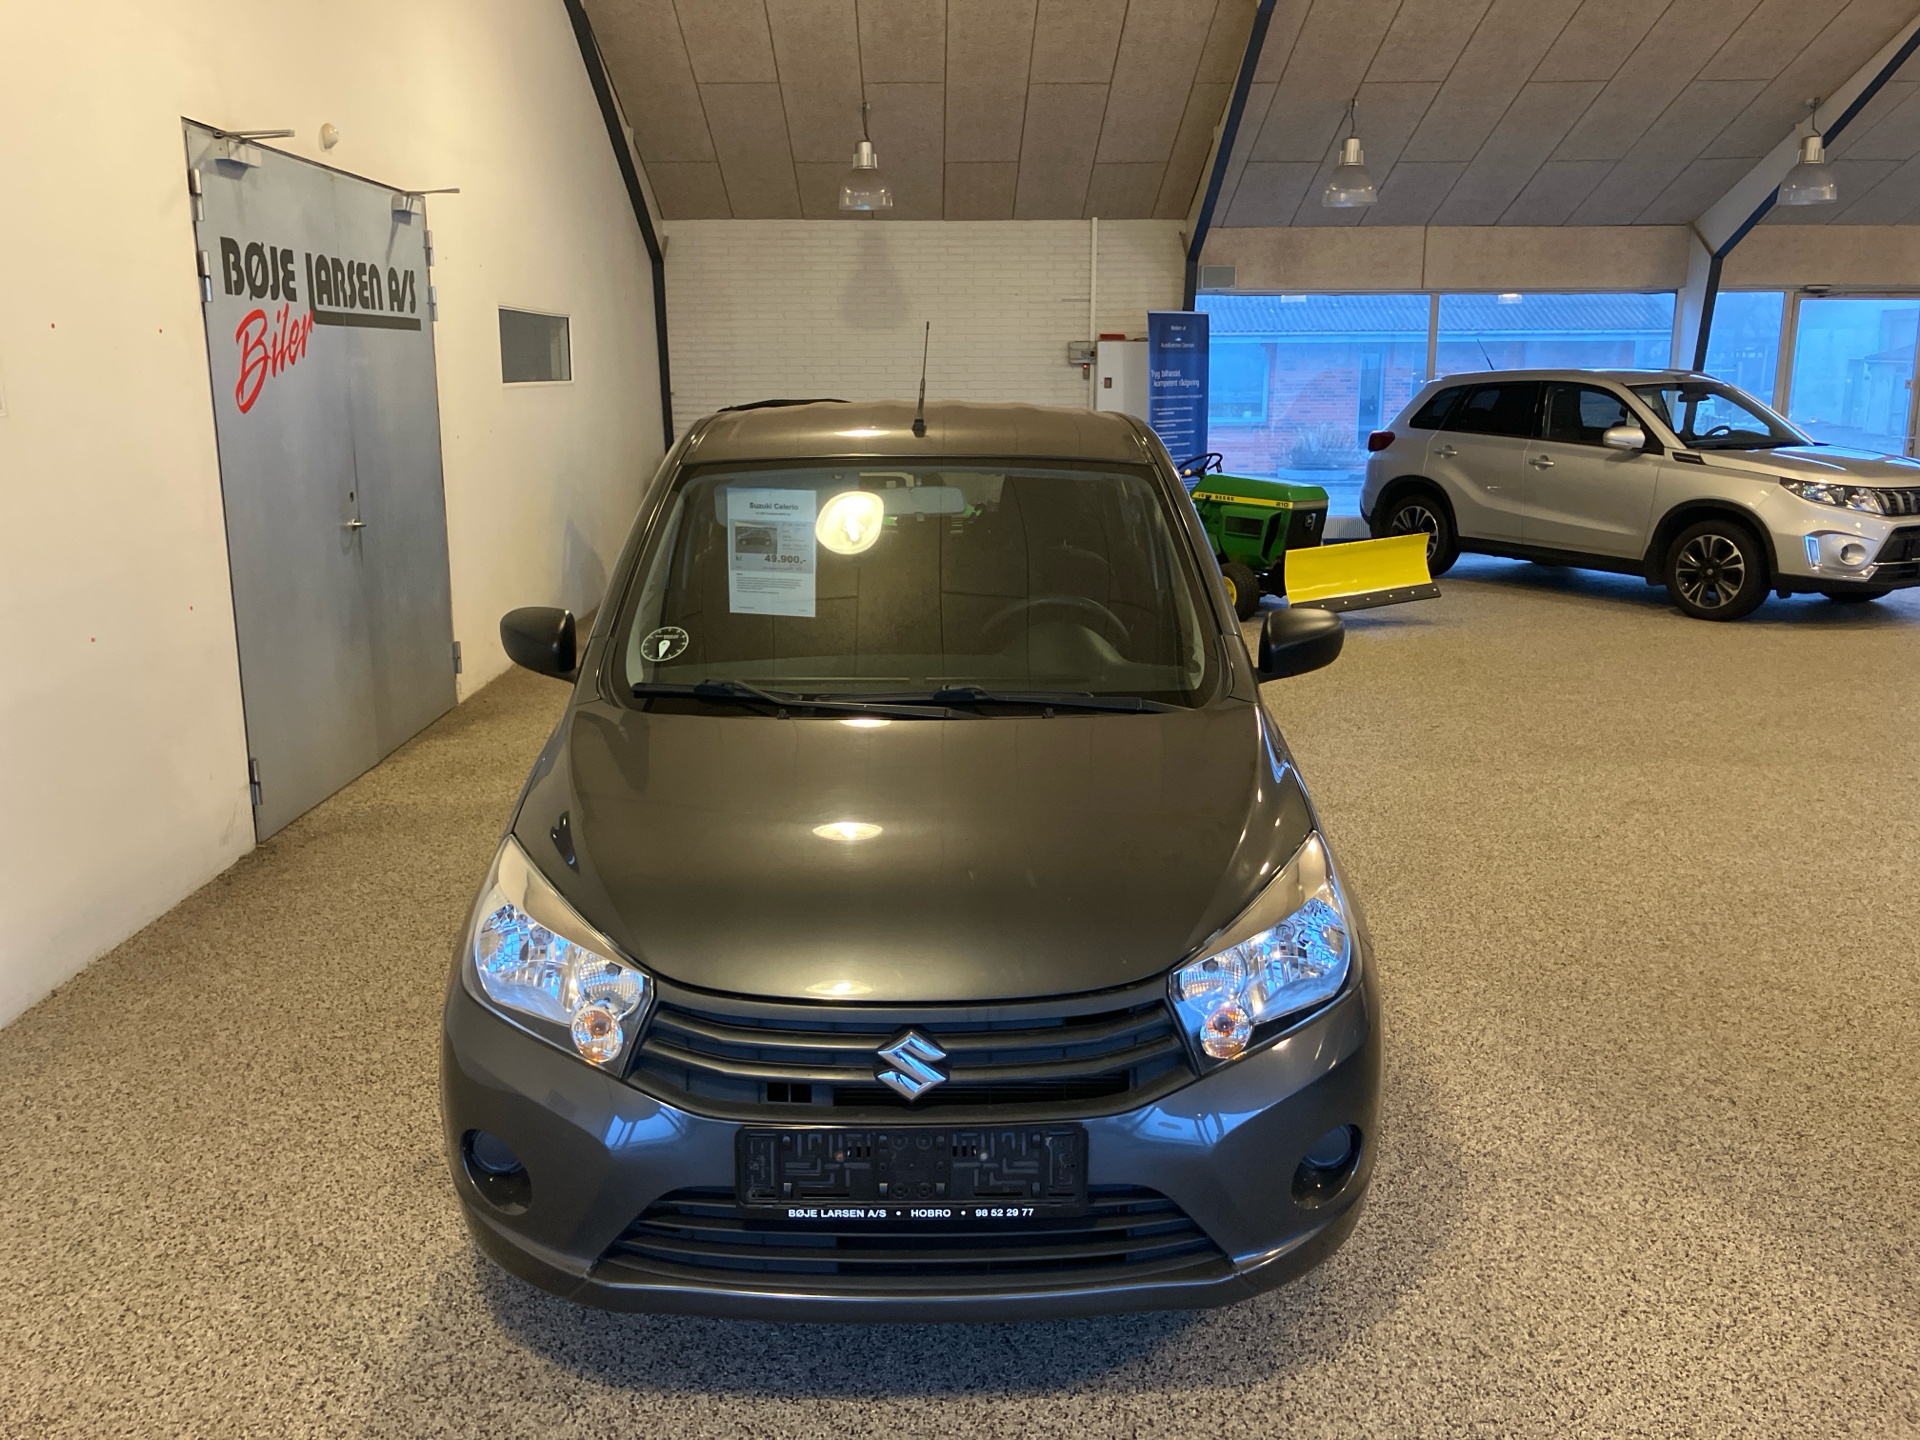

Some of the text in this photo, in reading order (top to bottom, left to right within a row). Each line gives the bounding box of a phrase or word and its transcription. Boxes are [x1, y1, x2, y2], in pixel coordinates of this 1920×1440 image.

[219, 236, 416, 318] BØJE LARSEN A/S
[235, 302, 314, 414] Biler
[749, 502, 799, 511] Suzuki Celerio
[764, 553, 807, 565] 49.900,-
[788, 1208, 1034, 1218] BØJE LARSEN A/S HOBRO 98 52 29 77
